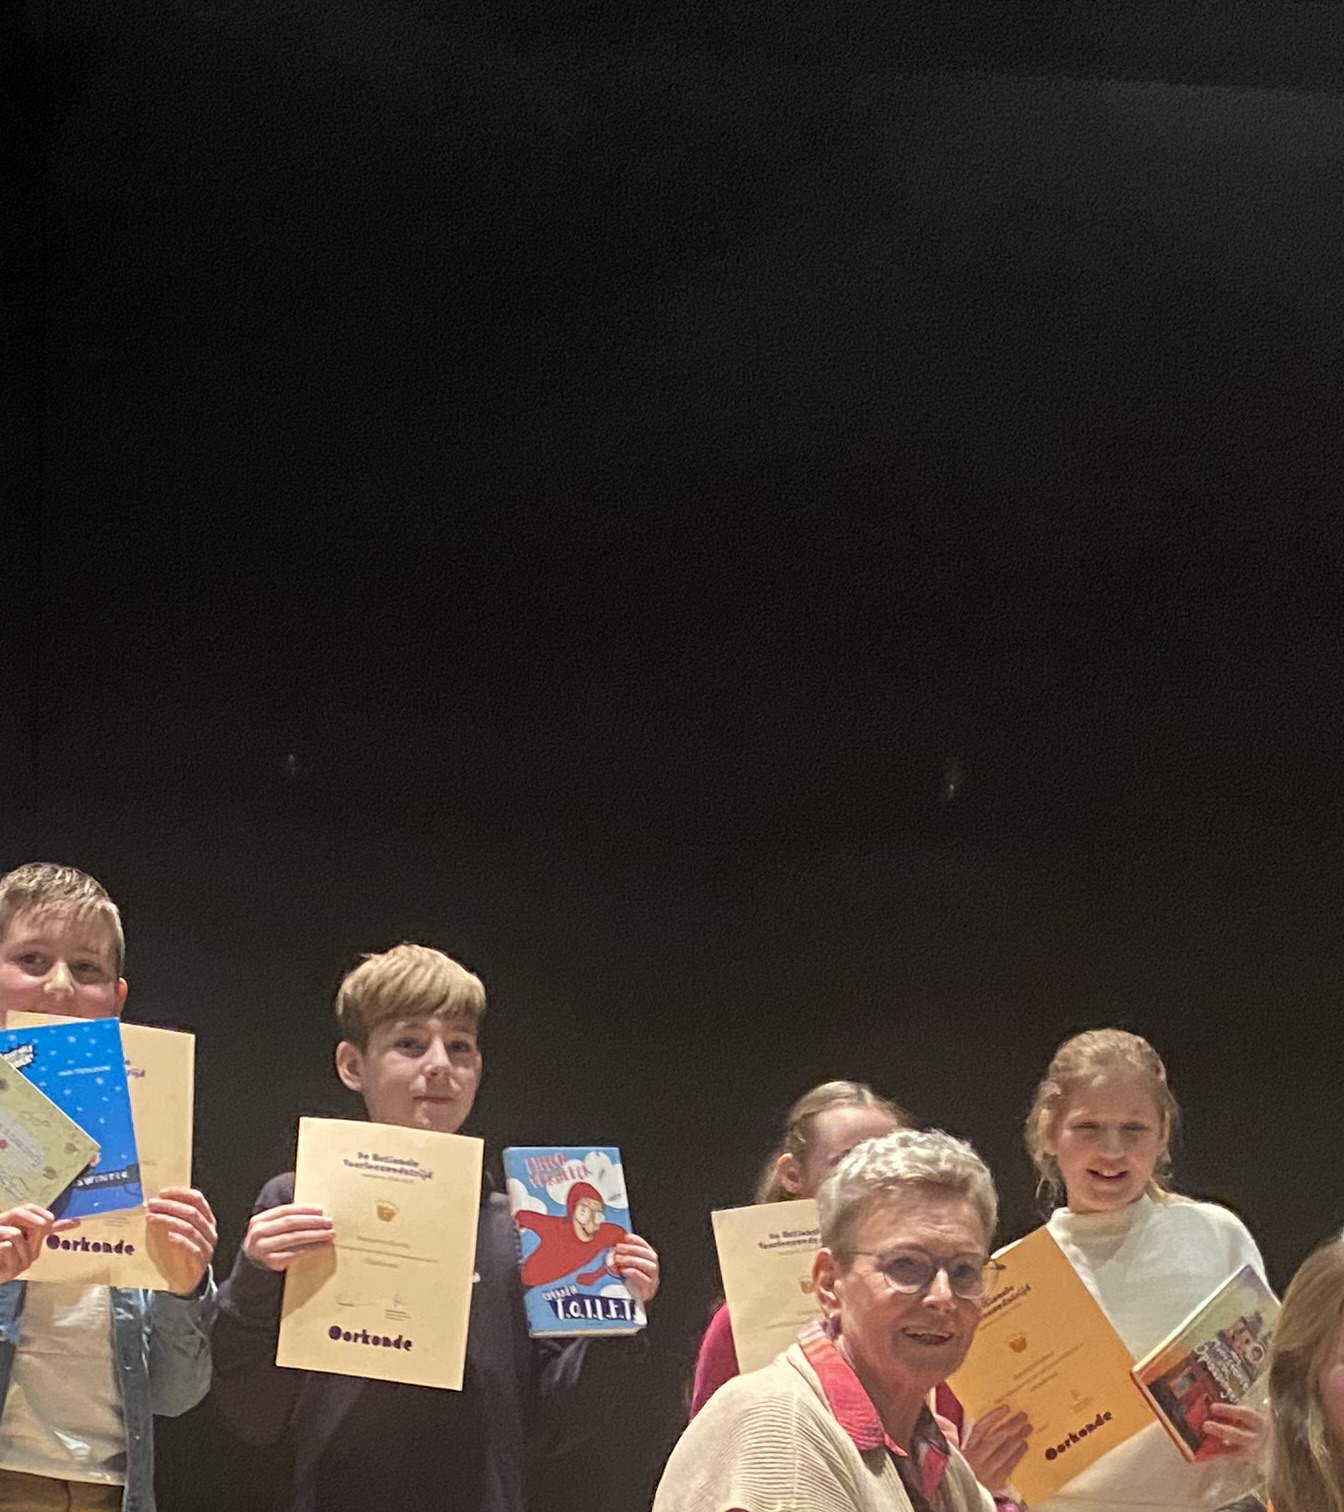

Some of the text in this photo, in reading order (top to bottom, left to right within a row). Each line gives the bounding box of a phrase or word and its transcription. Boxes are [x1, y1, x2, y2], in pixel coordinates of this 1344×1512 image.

[46, 1234, 135, 1256] Oorkonde
[328, 1325, 412, 1352] Oorkonde
[1044, 1411, 1114, 1461] Oorkonde
